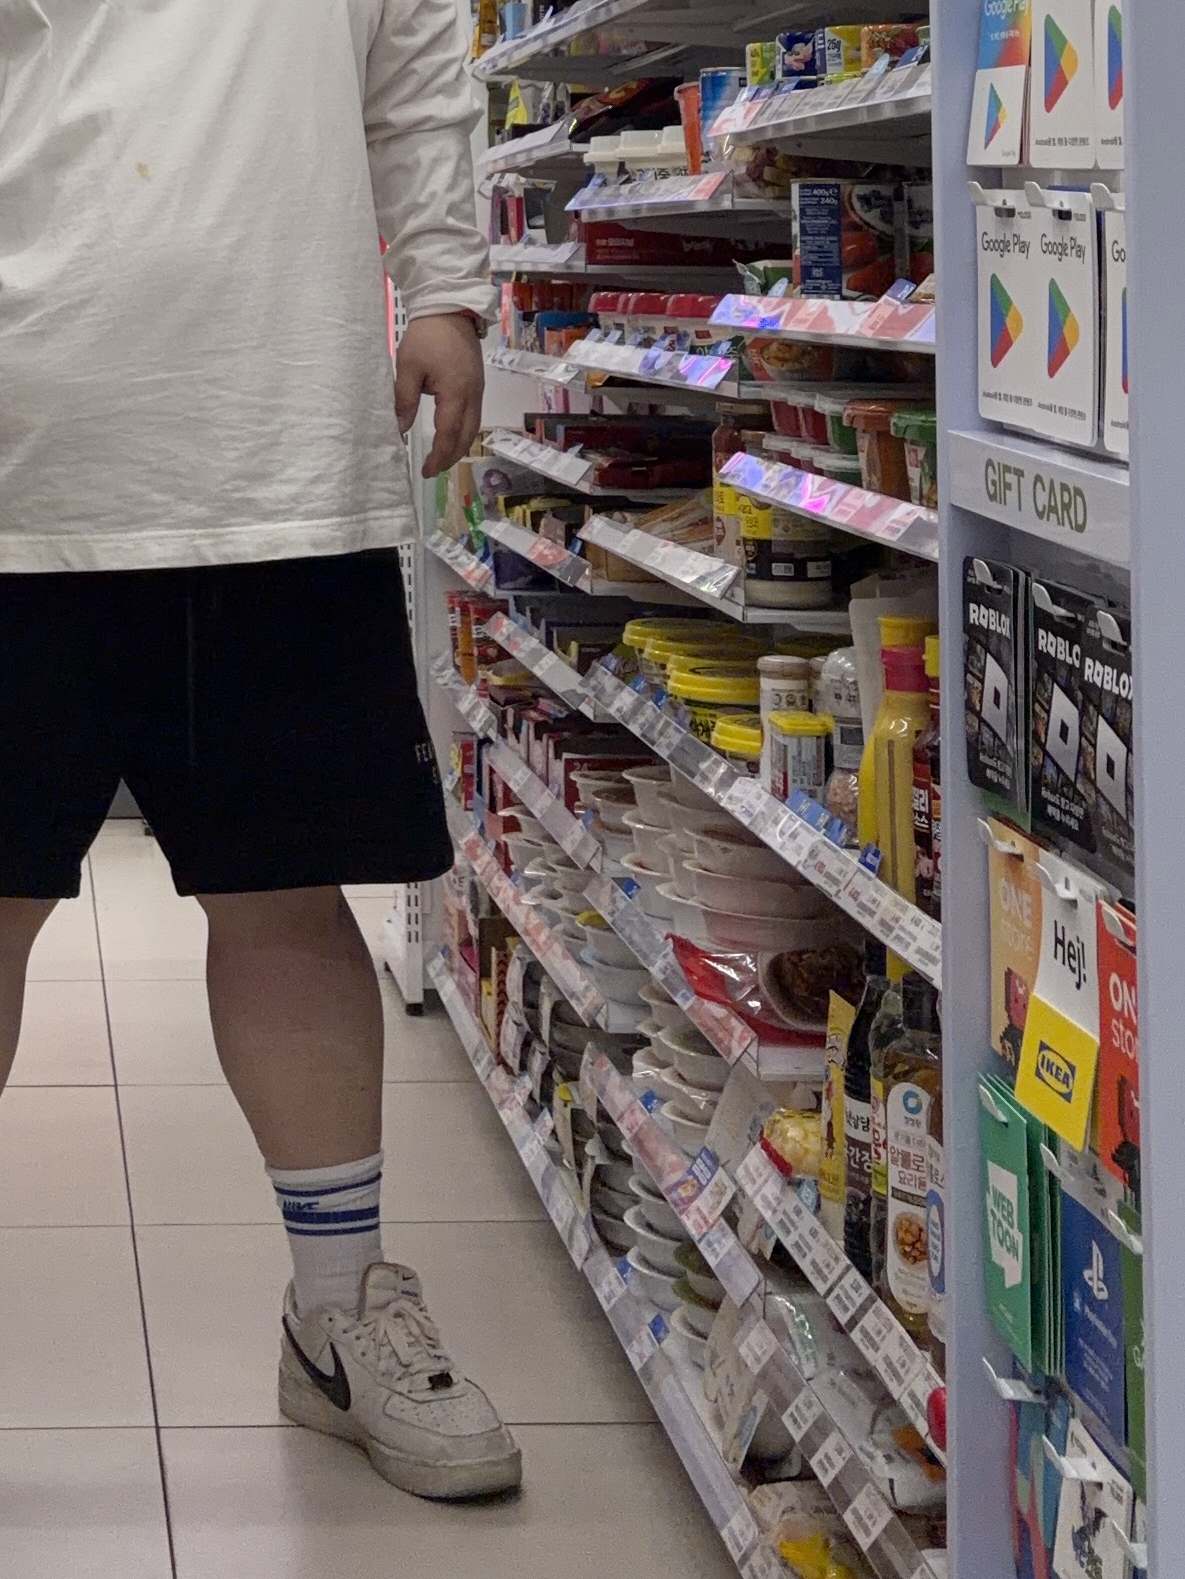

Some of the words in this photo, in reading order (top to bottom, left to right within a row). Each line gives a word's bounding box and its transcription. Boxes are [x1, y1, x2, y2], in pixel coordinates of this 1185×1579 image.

[981, 231, 1011, 259] Google
[1012, 233, 1031, 260] Play
[1040, 232, 1069, 263] Google
[1069, 236, 1087, 265] Play
[984, 457, 1025, 513] GIFT
[1032, 472, 1088, 534] CARD
[969, 601, 1012, 640] ROBLOX
[1037, 627, 1081, 670] ROBLO
[1053, 919, 1088, 992] Hej!
[1108, 971, 1138, 1027] ON
[1039, 1052, 1073, 1087] IKEA
